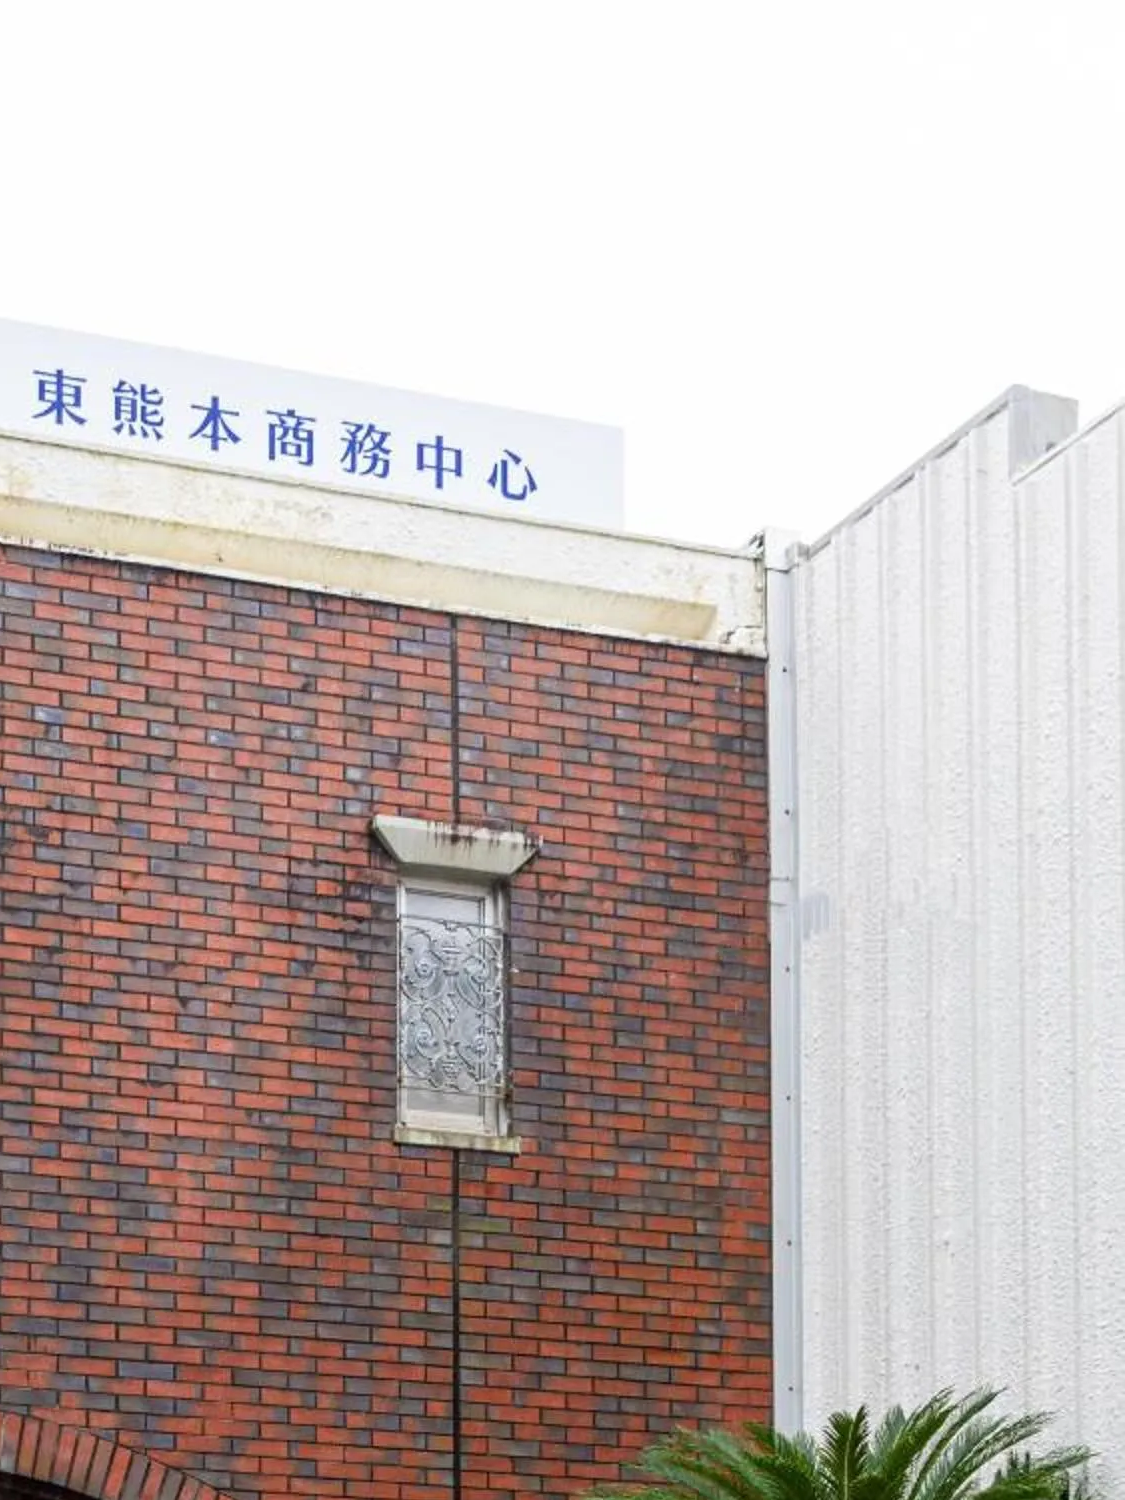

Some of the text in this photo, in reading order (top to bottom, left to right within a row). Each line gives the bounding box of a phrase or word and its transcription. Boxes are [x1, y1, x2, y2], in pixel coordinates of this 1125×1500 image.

[32, 368, 538, 501] 東熊本商務中心
